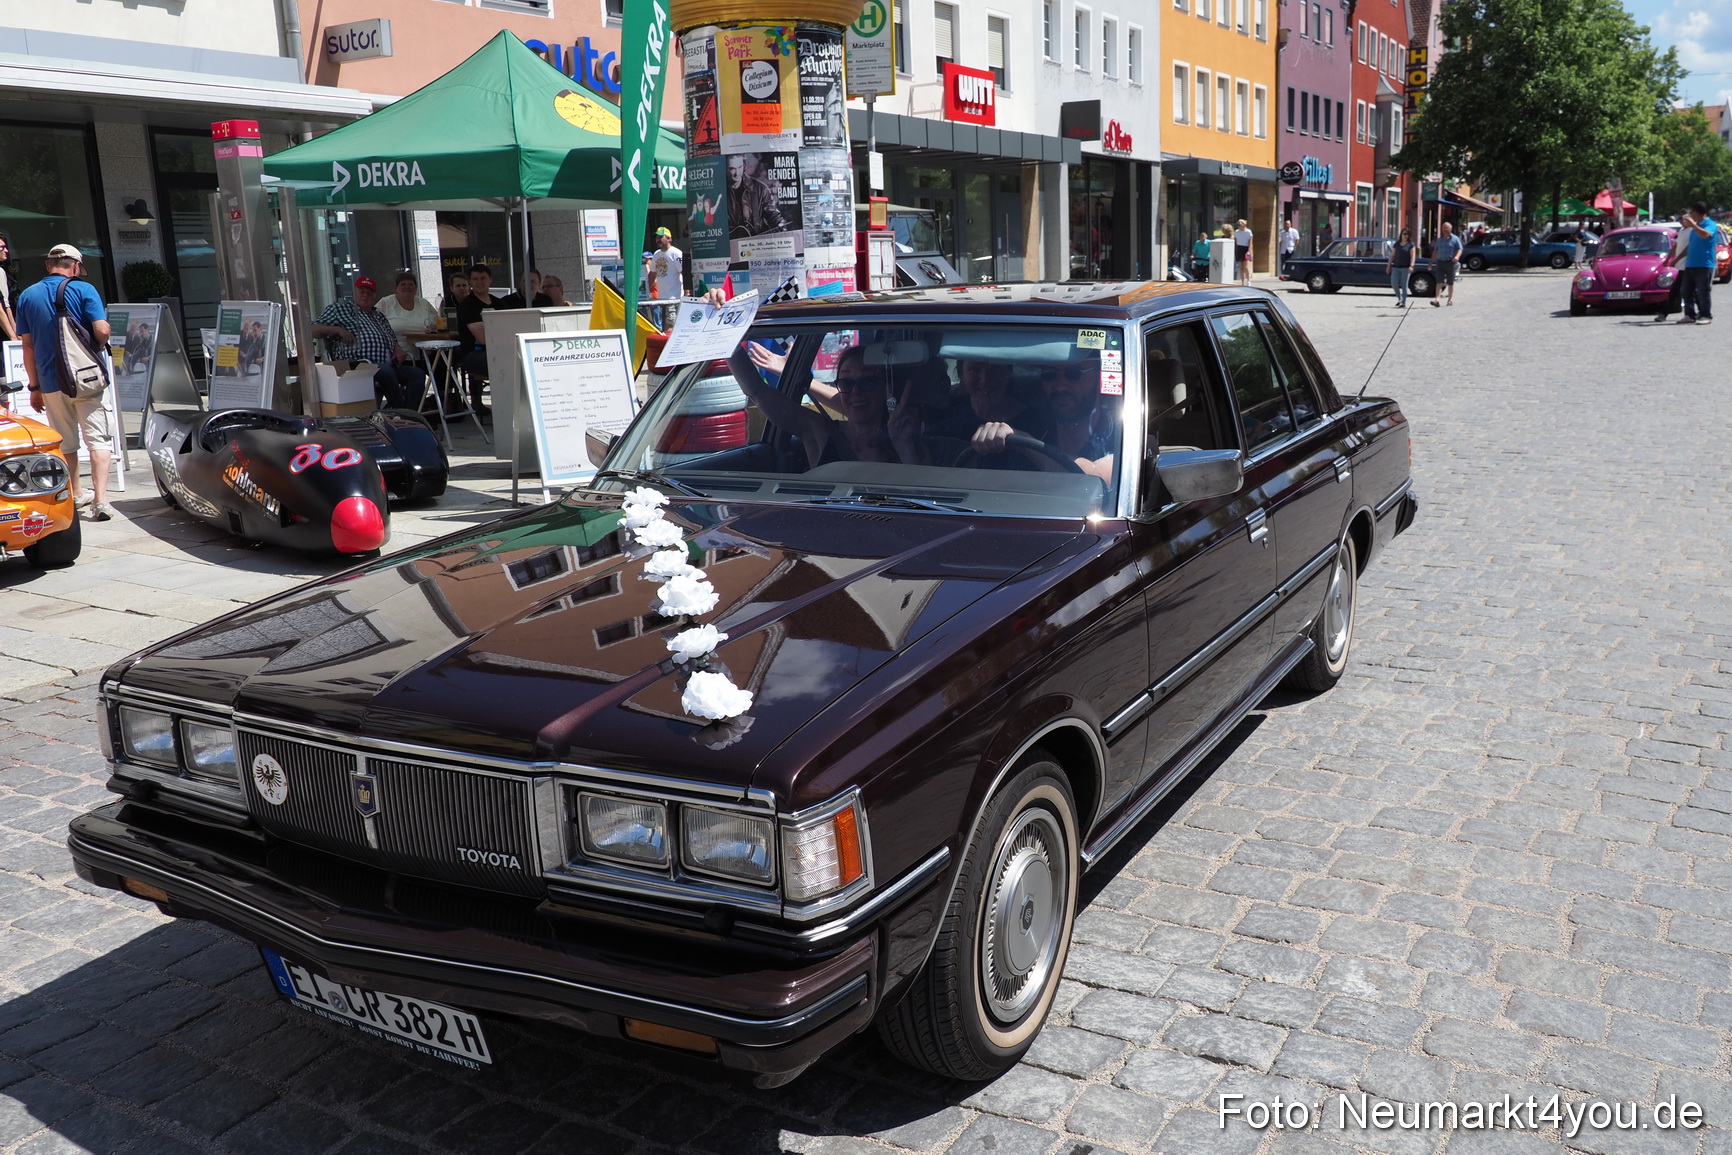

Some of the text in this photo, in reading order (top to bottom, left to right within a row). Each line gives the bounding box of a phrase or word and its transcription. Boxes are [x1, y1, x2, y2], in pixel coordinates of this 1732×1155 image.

[728, 45, 753, 60] Park
[636, 0, 666, 143] DEKRA
[744, 69, 773, 83] Collegium
[748, 80, 772, 92] Dixicum
[958, 74, 994, 106] WITT
[774, 156, 796, 168] MARK
[358, 161, 426, 188] DEKRA
[768, 169, 797, 180] BENDER
[777, 187, 798, 198] BAND
[707, 228, 723, 237] 2018
[763, 259, 781, 267] Jahre
[717, 309, 744, 326] 137
[1080, 330, 1105, 338] ADAC
[566, 339, 601, 350] DEKRA
[534, 351, 622, 362] RENNFAHRZEUGSCHAU
[457, 847, 521, 870] TOYOTA
[279, 976, 288, 987] D
[290, 998, 481, 1071] NICHT ANFASSEN! SONST KOMMT DIE ZAHNFEE!
